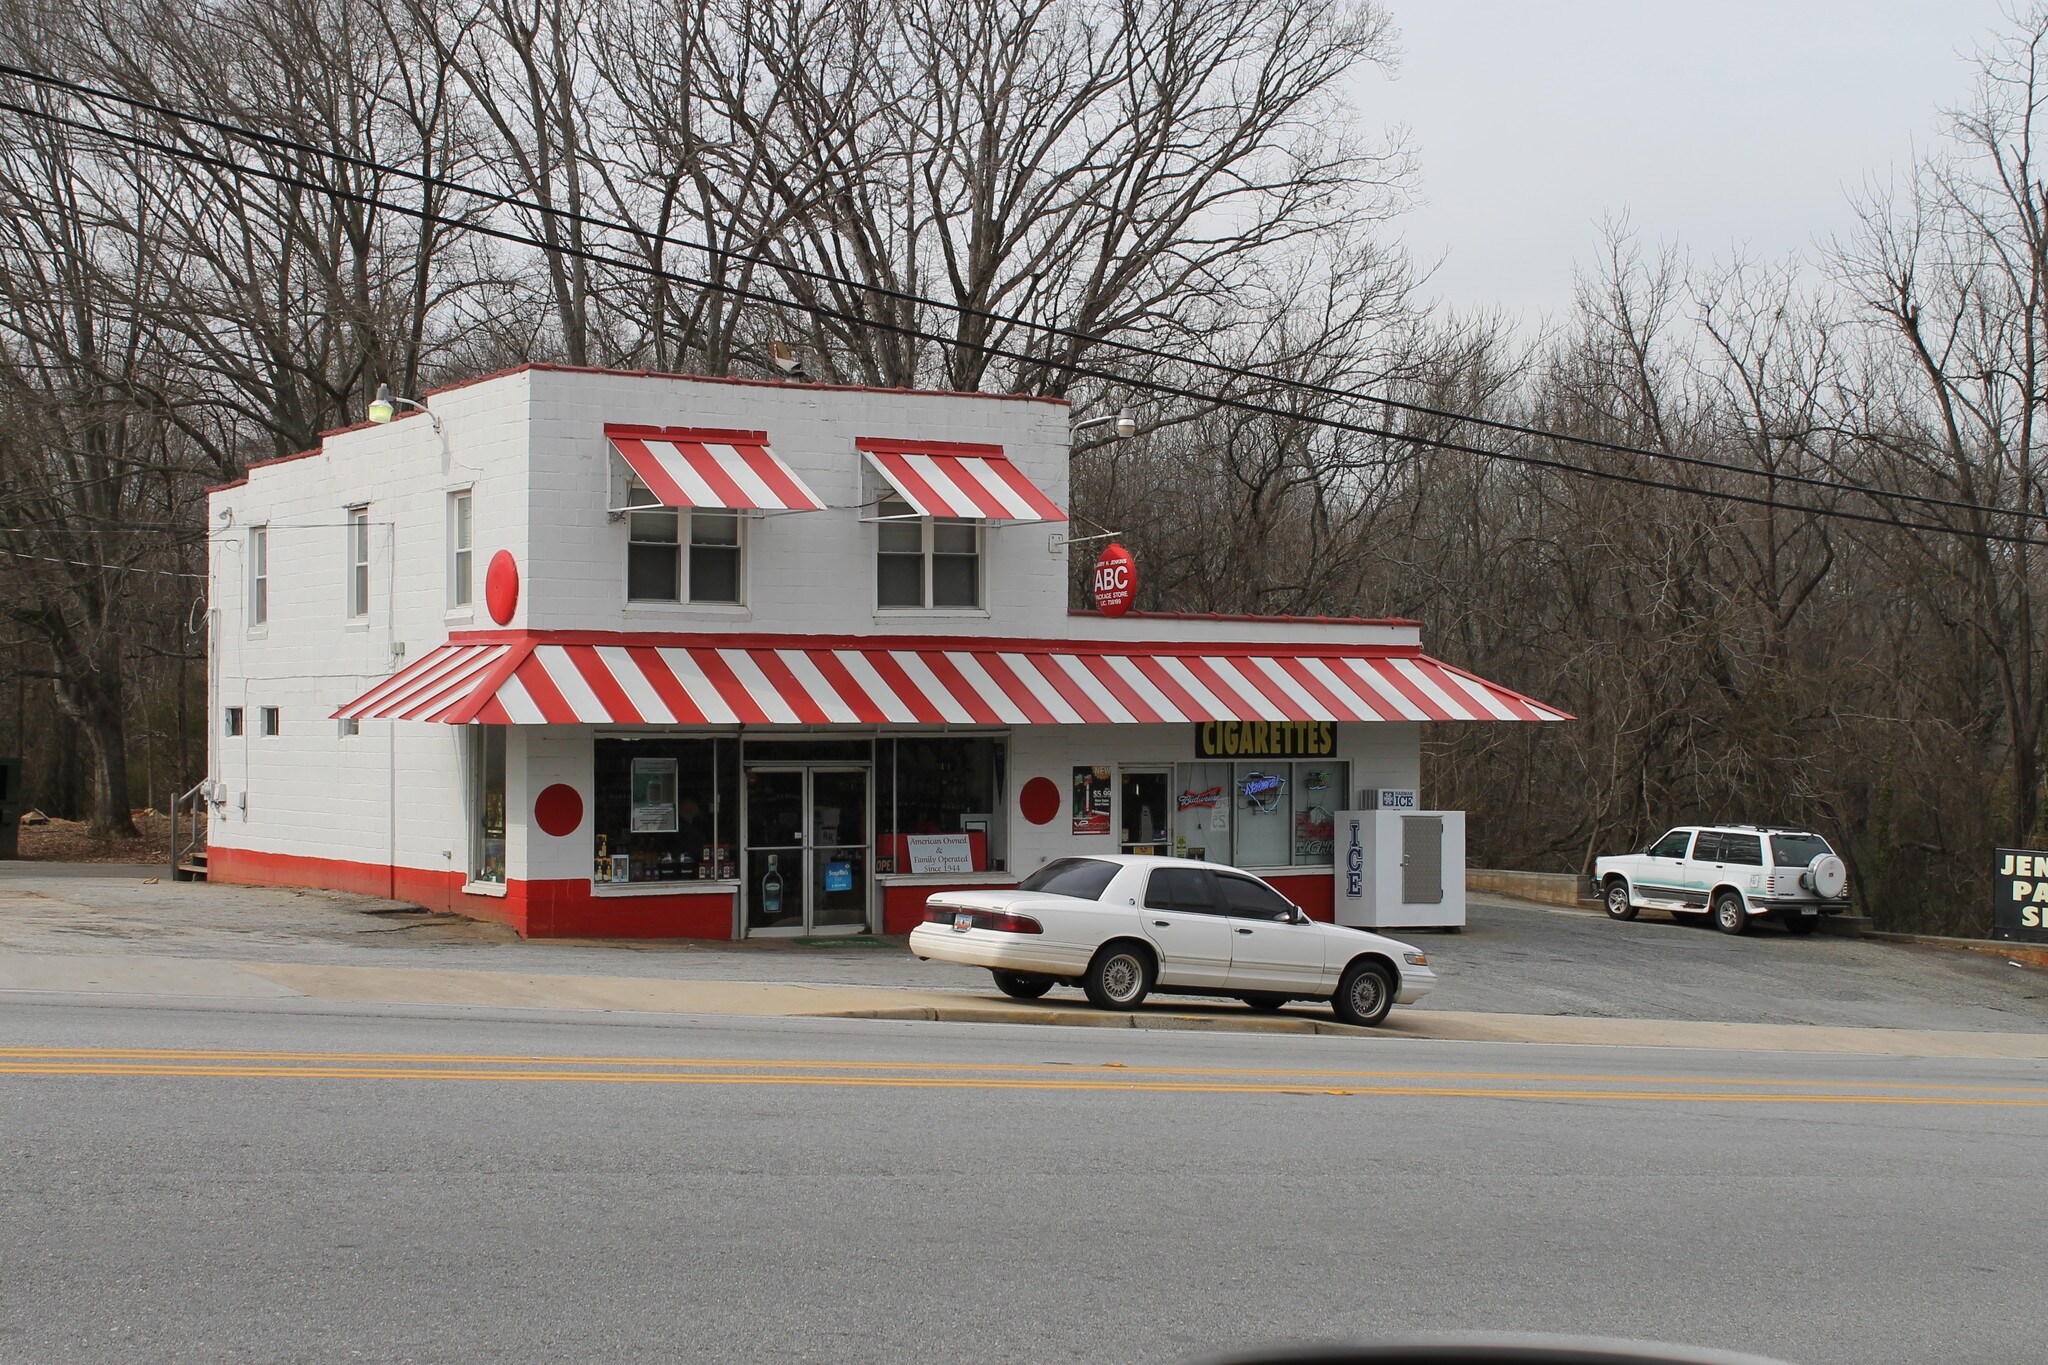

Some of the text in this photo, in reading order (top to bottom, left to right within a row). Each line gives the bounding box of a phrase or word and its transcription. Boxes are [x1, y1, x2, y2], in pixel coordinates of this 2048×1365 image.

[1094, 565, 1128, 592] ABC
[1202, 721, 1332, 755] CIGARETTES
[1094, 766, 1111, 774] NEW
[1093, 790, 1111, 798] $5.99
[1395, 796, 1413, 807] ICE
[910, 836, 967, 845] American Owned
[914, 855, 968, 865] Family Operated
[1347, 822, 1363, 897] ICE
[924, 864, 960, 872] Since 1944
[2001, 855, 2048, 877] JEN
[2012, 881, 2048, 903] PA
